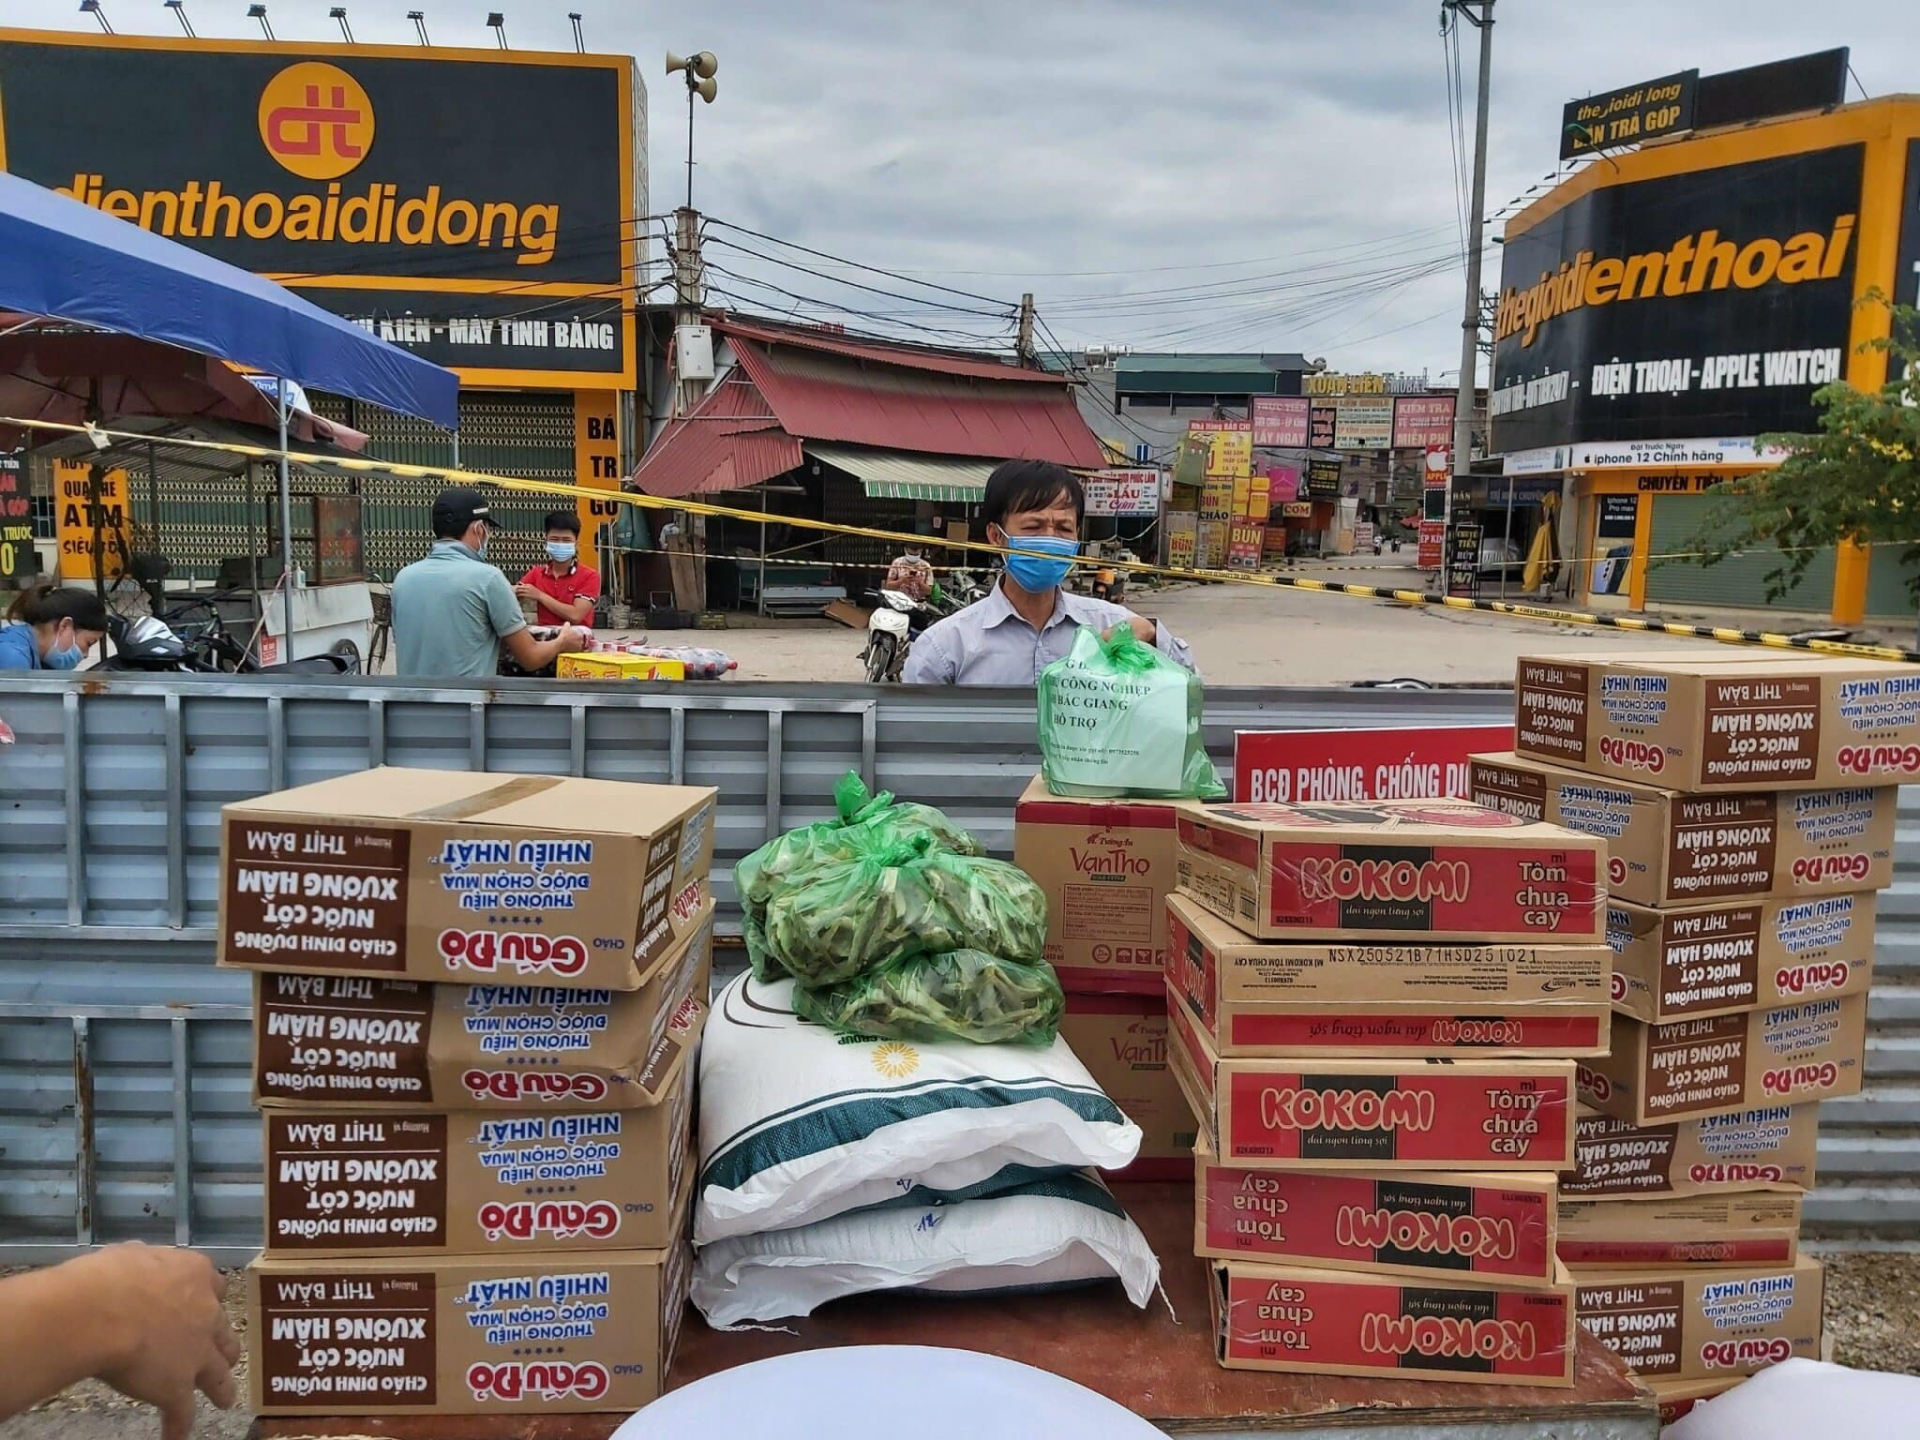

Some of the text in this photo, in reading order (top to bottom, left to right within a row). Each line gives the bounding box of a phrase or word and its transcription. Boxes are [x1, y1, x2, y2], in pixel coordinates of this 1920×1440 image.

[1646, 84, 1681, 102] long
[1611, 105, 1680, 139] TRẢ GÓP
[380, 310, 430, 346] KIỆN
[450, 314, 493, 344] MÁY
[555, 316, 613, 350] BẢNG
[1592, 358, 1632, 400] ĐIỆN
[1764, 348, 1840, 384] WATCH
[1594, 455, 1632, 465] iphone
[1636, 453, 1649, 462] 12
[1653, 450, 1688, 462] Chính
[64, 504, 122, 528] ATM
[1232, 526, 1261, 545] BÚN
[1061, 677, 1150, 696] CÔNG NGHIỆP
[1601, 675, 1668, 695] NHIỀU NHẤT
[1751, 683, 1783, 701] THỊT
[1084, 698, 1128, 710] GIANG
[1522, 694, 1584, 715] XƯƠNG HẦM
[1711, 713, 1816, 738] XƯƠNG HẦM
[1728, 734, 1800, 760] NƯỚC CỐT
[1251, 769, 1290, 802] BCĐ
[1376, 751, 1440, 800] CHỐNG
[247, 830, 346, 859] THỊT BẰM
[1676, 826, 1771, 853] XƯƠNG HẦM
[441, 839, 593, 875] NHIỀU NHẤT
[440, 873, 590, 890] ĐƯỢC CHỌN MUA
[1300, 857, 1470, 902] KOKOMI
[1518, 861, 1566, 882] Tôm
[237, 868, 398, 902] XƯƠNG HẦM
[459, 890, 574, 909] THƯƠNG HIỆU
[1516, 886, 1569, 907] chua
[263, 898, 375, 932] NƯỚC CỐT
[1523, 909, 1561, 930] cay
[234, 930, 397, 959] CHÁO DINH DƯỠNG
[593, 936, 625, 950] CHÁO
[1666, 940, 1753, 968] XƯƠNG HẦM
[1268, 960, 1283, 968] TÔM
[267, 1011, 421, 1047] XƯƠNG HẦM
[1365, 1025, 1401, 1039] ngon
[1432, 1020, 1523, 1042] KOKOMI
[480, 1033, 591, 1052] THƯƠNG HIỆU
[290, 1041, 396, 1074] NƯỚC CỐT
[1653, 1041, 1741, 1071] XƯƠNG HẦM
[1261, 1088, 1435, 1132] KOKOMI
[1486, 1089, 1536, 1110] Tôm
[342, 1121, 385, 1143] THỊT
[1482, 1115, 1538, 1135] chua
[1491, 1137, 1530, 1158] cay
[279, 1159, 437, 1192] XƯƠNG HẦM
[1241, 1173, 1280, 1194] cay
[1233, 1194, 1289, 1217] chua
[1236, 1220, 1286, 1242] Tôm
[1336, 1205, 1515, 1260] KOKOMI
[465, 1273, 609, 1308] NHIỀU NHẤT
[1266, 1282, 1306, 1302] cay
[1257, 1305, 1314, 1322] chua
[1260, 1328, 1310, 1351] Tôm
[1361, 1313, 1537, 1362] KOKOMI
[298, 1344, 404, 1376] NƯỚC CỐT
